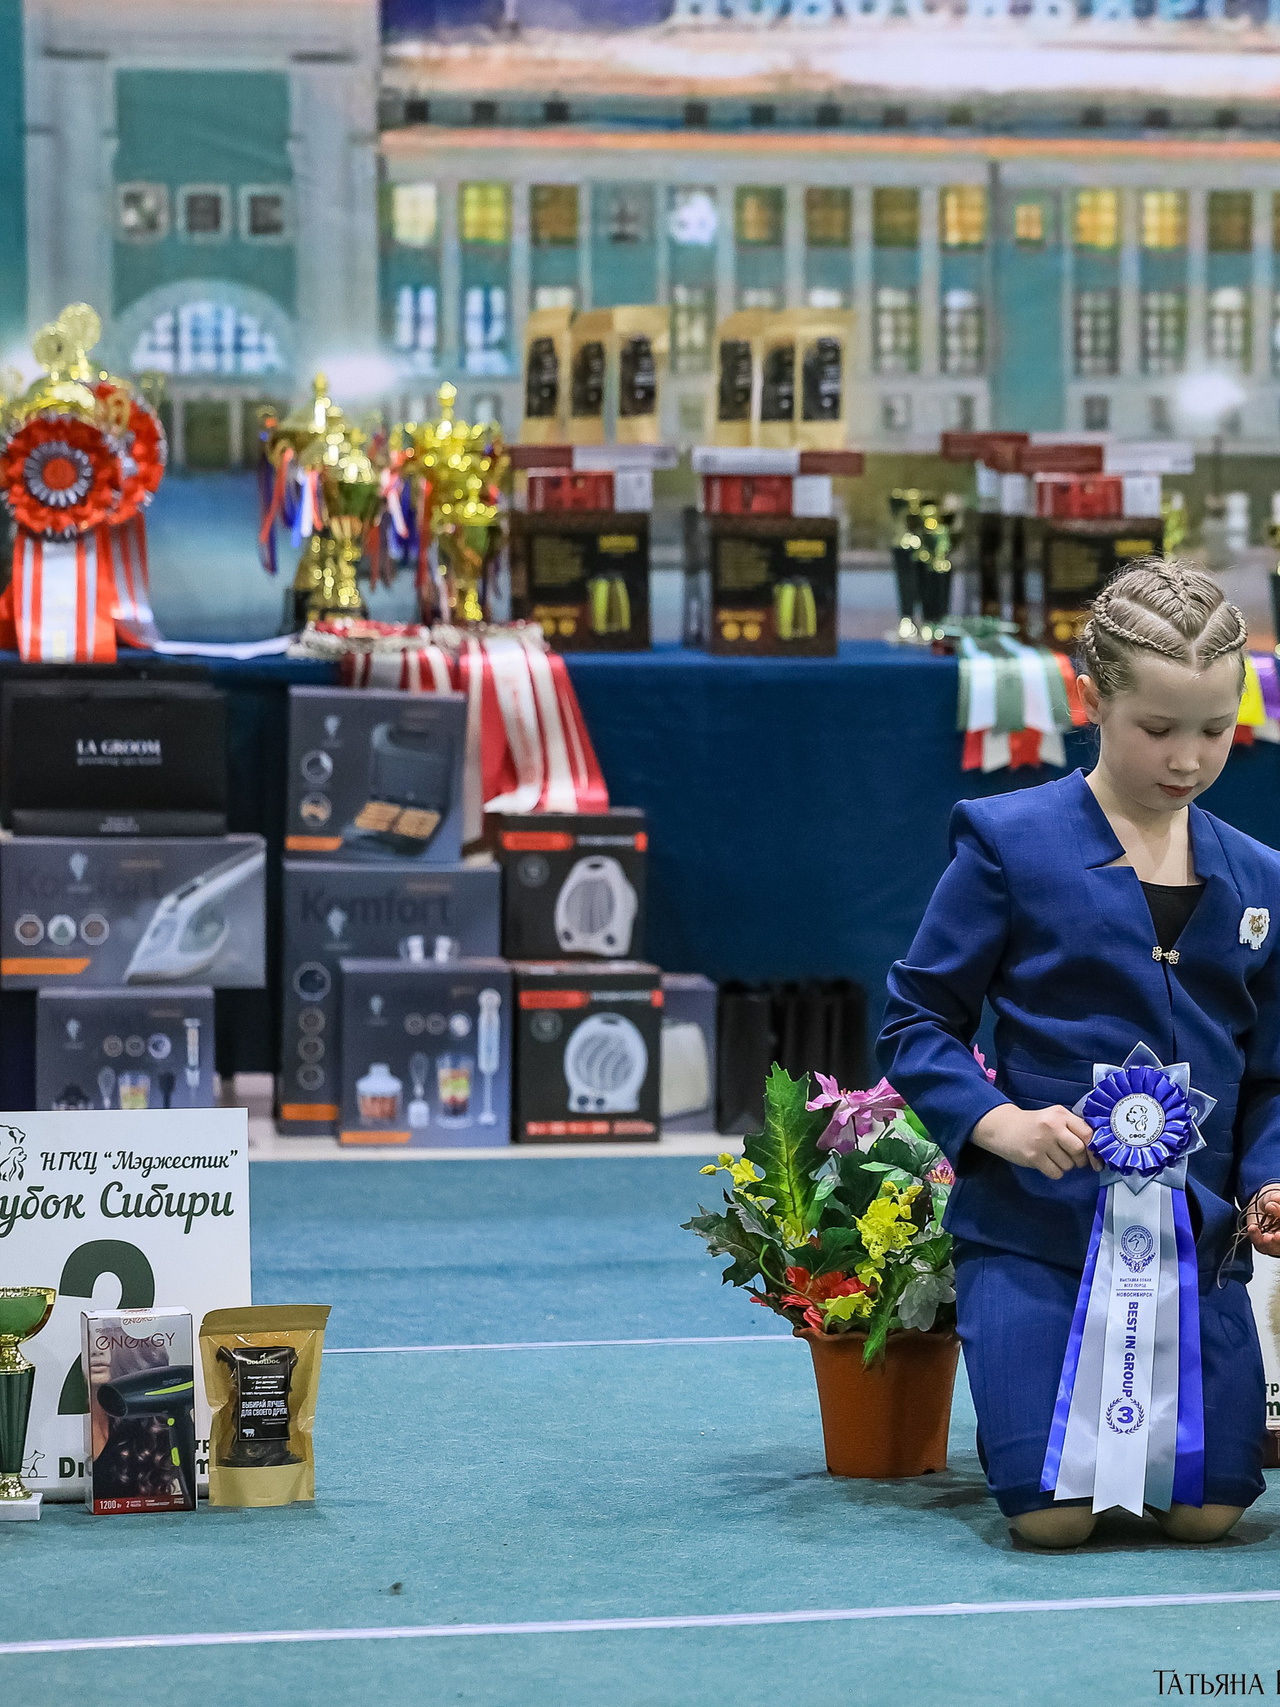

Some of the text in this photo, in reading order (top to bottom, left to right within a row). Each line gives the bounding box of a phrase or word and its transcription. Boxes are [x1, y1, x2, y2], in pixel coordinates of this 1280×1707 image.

[77, 738, 162, 756] LA GROOM
[40, 1151, 98, 1175] НГКЦ
[0, 1180, 235, 1238] убок Сибири
[1122, 1301, 1139, 1398] BEST IN GROUP
[241, 1399, 266, 1409] ВЫБИРАЙ
[253, 1408, 272, 1417] СВОЕГО
[1116, 1406, 1134, 1424] 3
[99, 1500, 117, 1510] 1200
